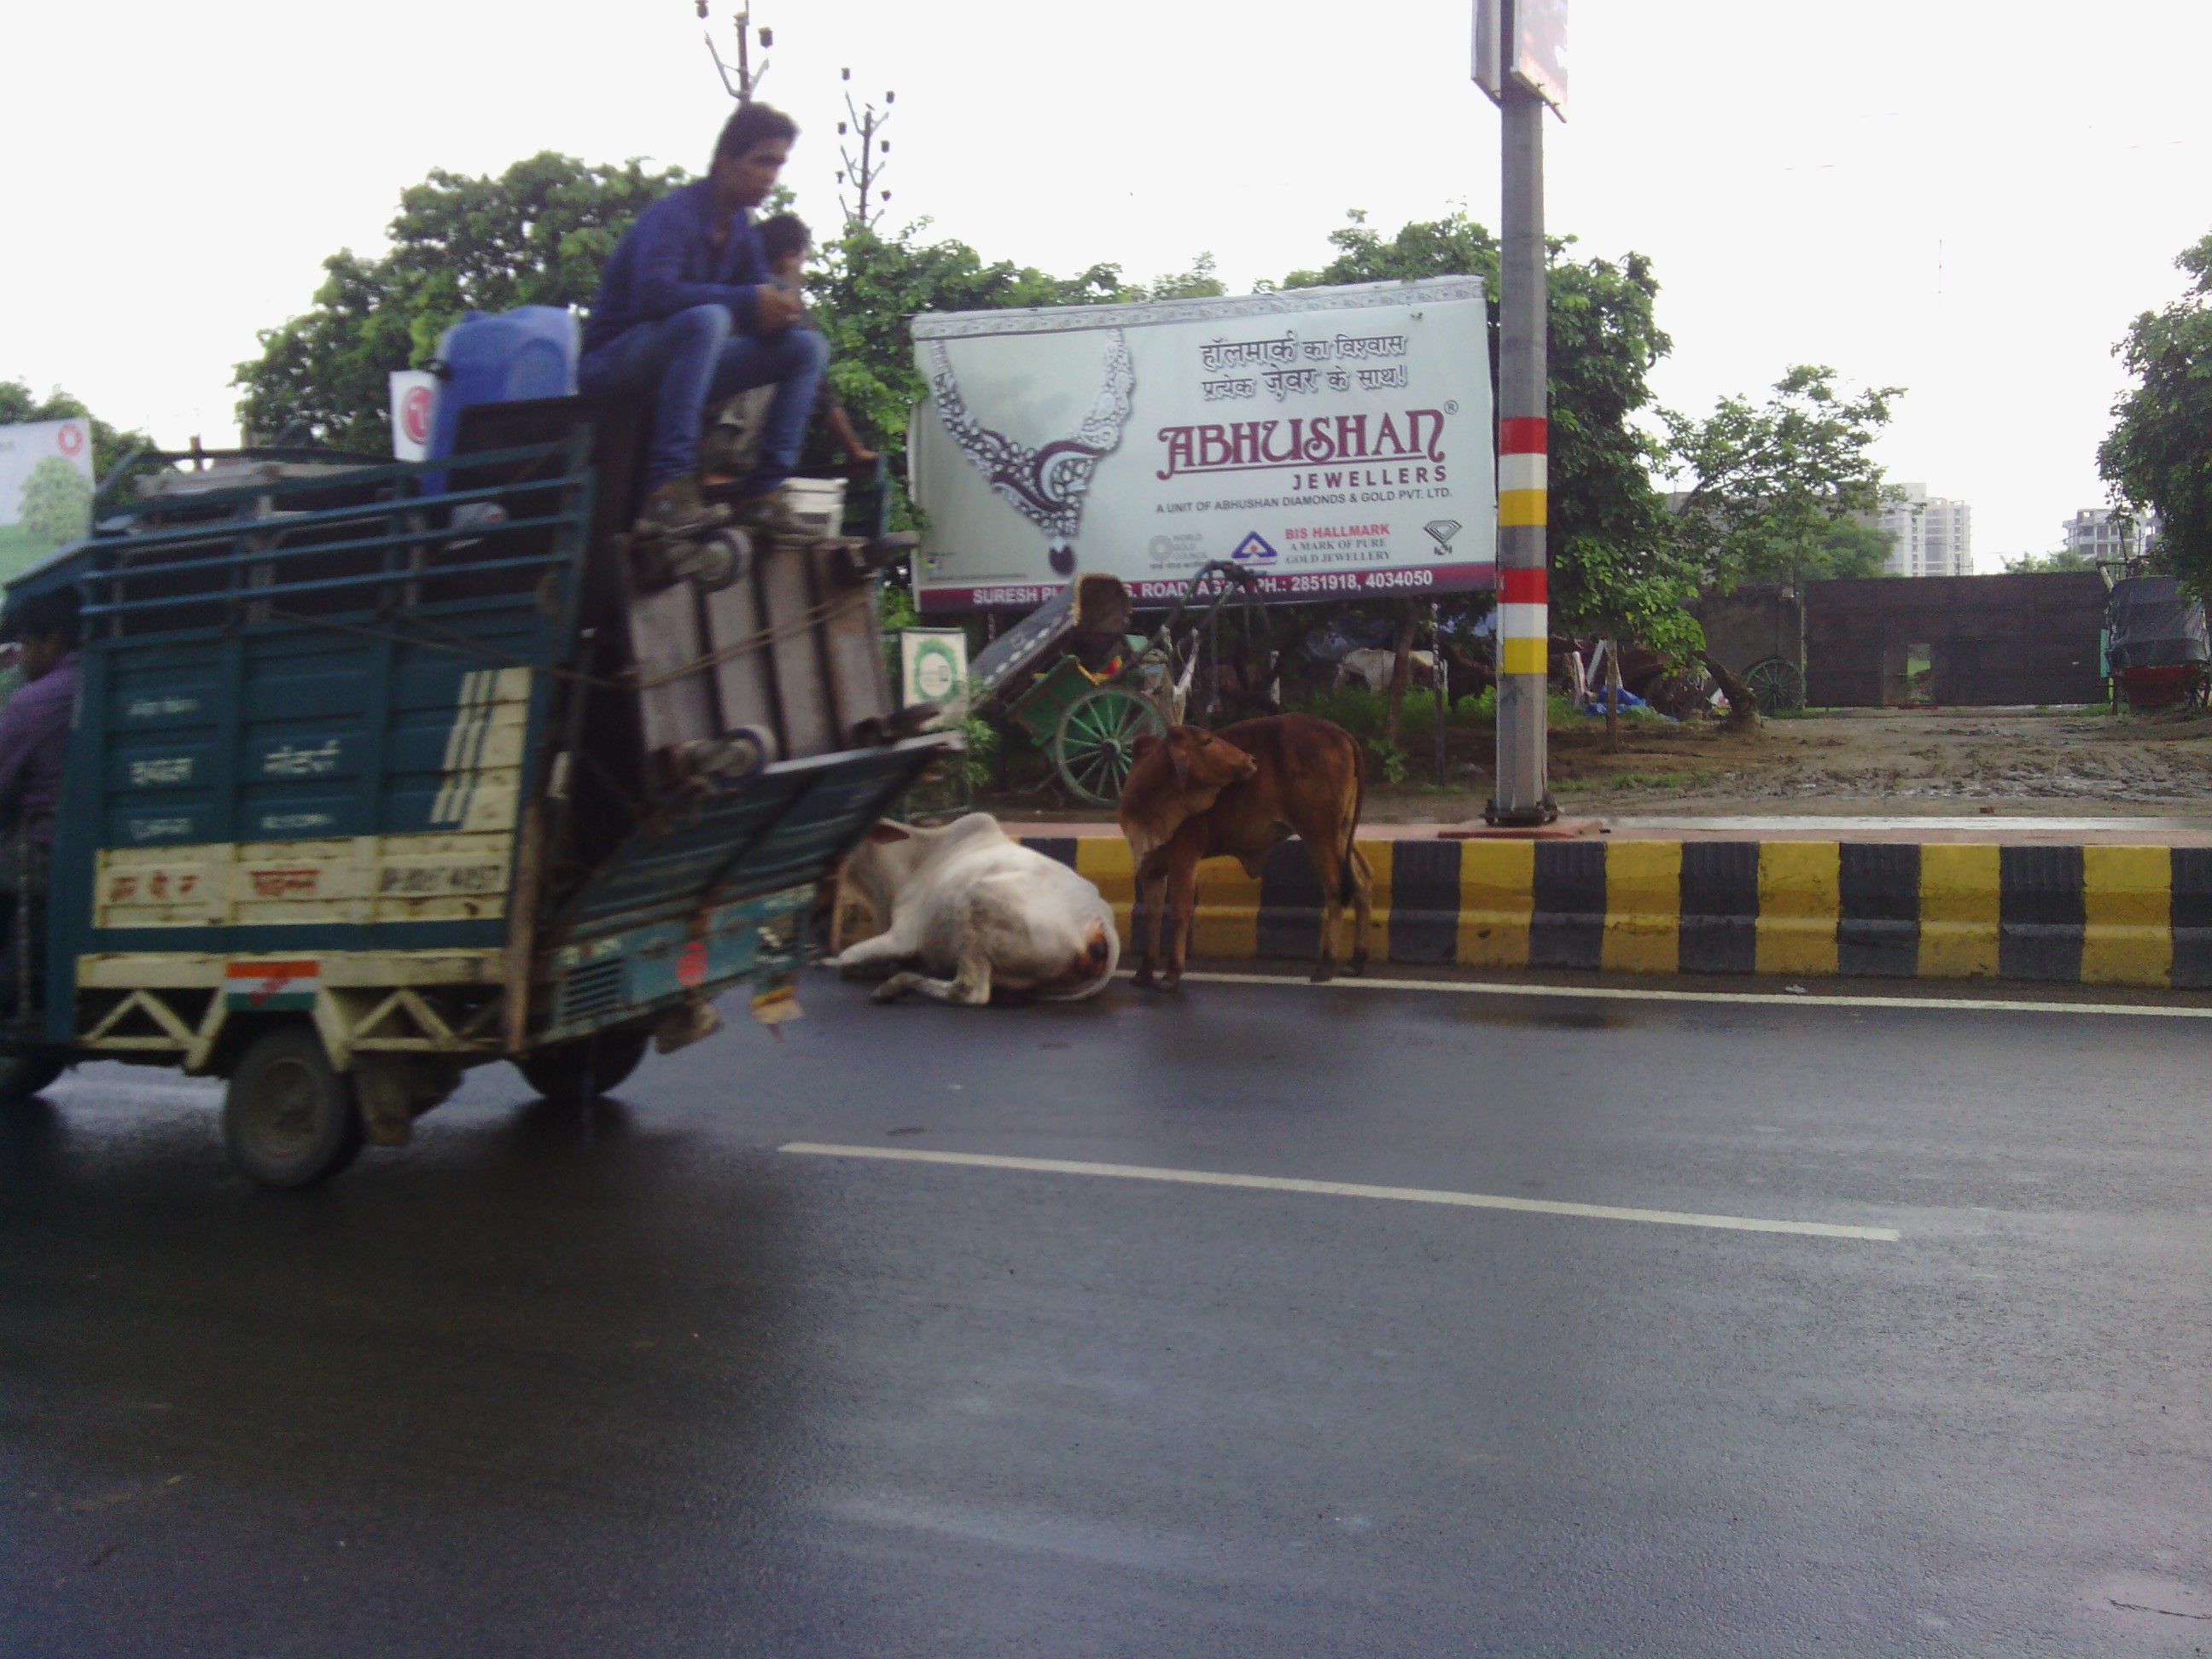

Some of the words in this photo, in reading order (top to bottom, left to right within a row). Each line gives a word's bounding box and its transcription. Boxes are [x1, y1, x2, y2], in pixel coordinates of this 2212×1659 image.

[1199, 330, 1295, 370] हॉलमार्क
[1302, 341, 1330, 360] का
[1335, 334, 1406, 358] विश्वास
[1202, 374, 1254, 399] प्रत्येक
[1326, 366, 1348, 390] के
[1155, 409, 1446, 480] ABHUSHAN
[1292, 466, 1447, 491] JEWELLERS
[1156, 503, 1164, 513] A
[1167, 501, 1192, 513] UNIT
[1196, 500, 1212, 511] OF
[1214, 498, 1279, 510] ABHUSHAN
[1283, 493, 1346, 507] DIAMONDS
[1348, 492, 1357, 503] &
[1361, 491, 1395, 503] GOLD
[1399, 489, 1424, 501] PVT.
[1427, 487, 1452, 498] LTD.
[1285, 527, 1308, 539] BIS
[1313, 524, 1391, 538] HALLMARK
[1300, 540, 1335, 551] MARK
[1338, 539, 1352, 549] OF
[1355, 538, 1386, 548] PURE
[1285, 555, 1319, 565] GOLD
[1323, 550, 1391, 563] JEWELLERY
[972, 587, 1039, 605] SURESH
[1290, 574, 1362, 591] 2851918,
[1365, 571, 1433, 589] 4034050
